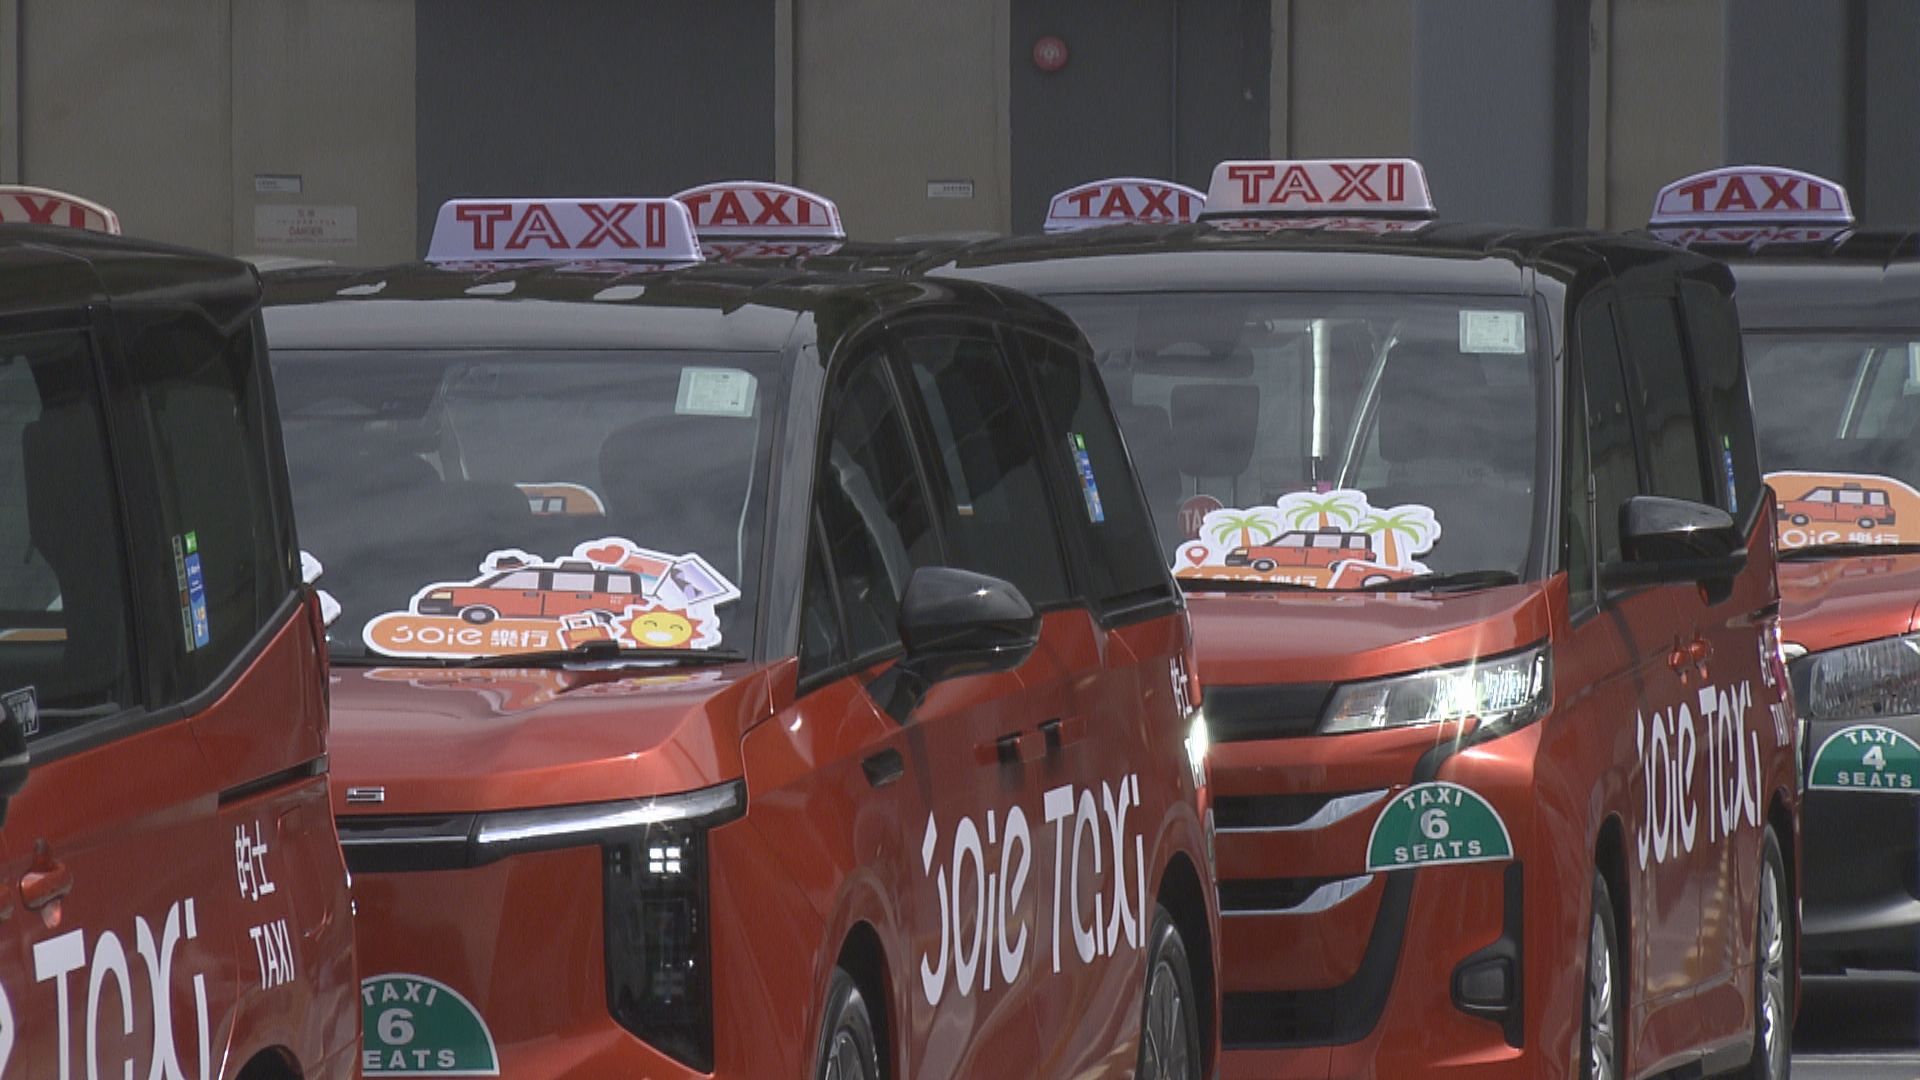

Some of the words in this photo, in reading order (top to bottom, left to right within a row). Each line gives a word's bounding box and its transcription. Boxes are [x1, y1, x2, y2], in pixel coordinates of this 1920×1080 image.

[1228, 164, 1404, 203] TAXI
[1679, 176, 1821, 212] TAXI
[0, 196, 85, 230] XI
[1068, 186, 1190, 223] TAXI
[456, 203, 666, 251] TAXI
[1844, 730, 1897, 746] TAXI
[1698, 680, 1762, 843] Taxi
[1862, 745, 1886, 771] 4
[1838, 771, 1912, 787] SEATS
[1403, 788, 1462, 810] TAXI
[1420, 808, 1450, 839] 6
[235, 820, 275, 901] 的士
[1394, 840, 1482, 862] SEATS
[1044, 774, 1146, 973] Taxi
[250, 919, 295, 990] TAXI
[362, 982, 437, 1006] TAXI
[378, 1008, 415, 1045] 6
[363, 1050, 455, 1069] EATS
